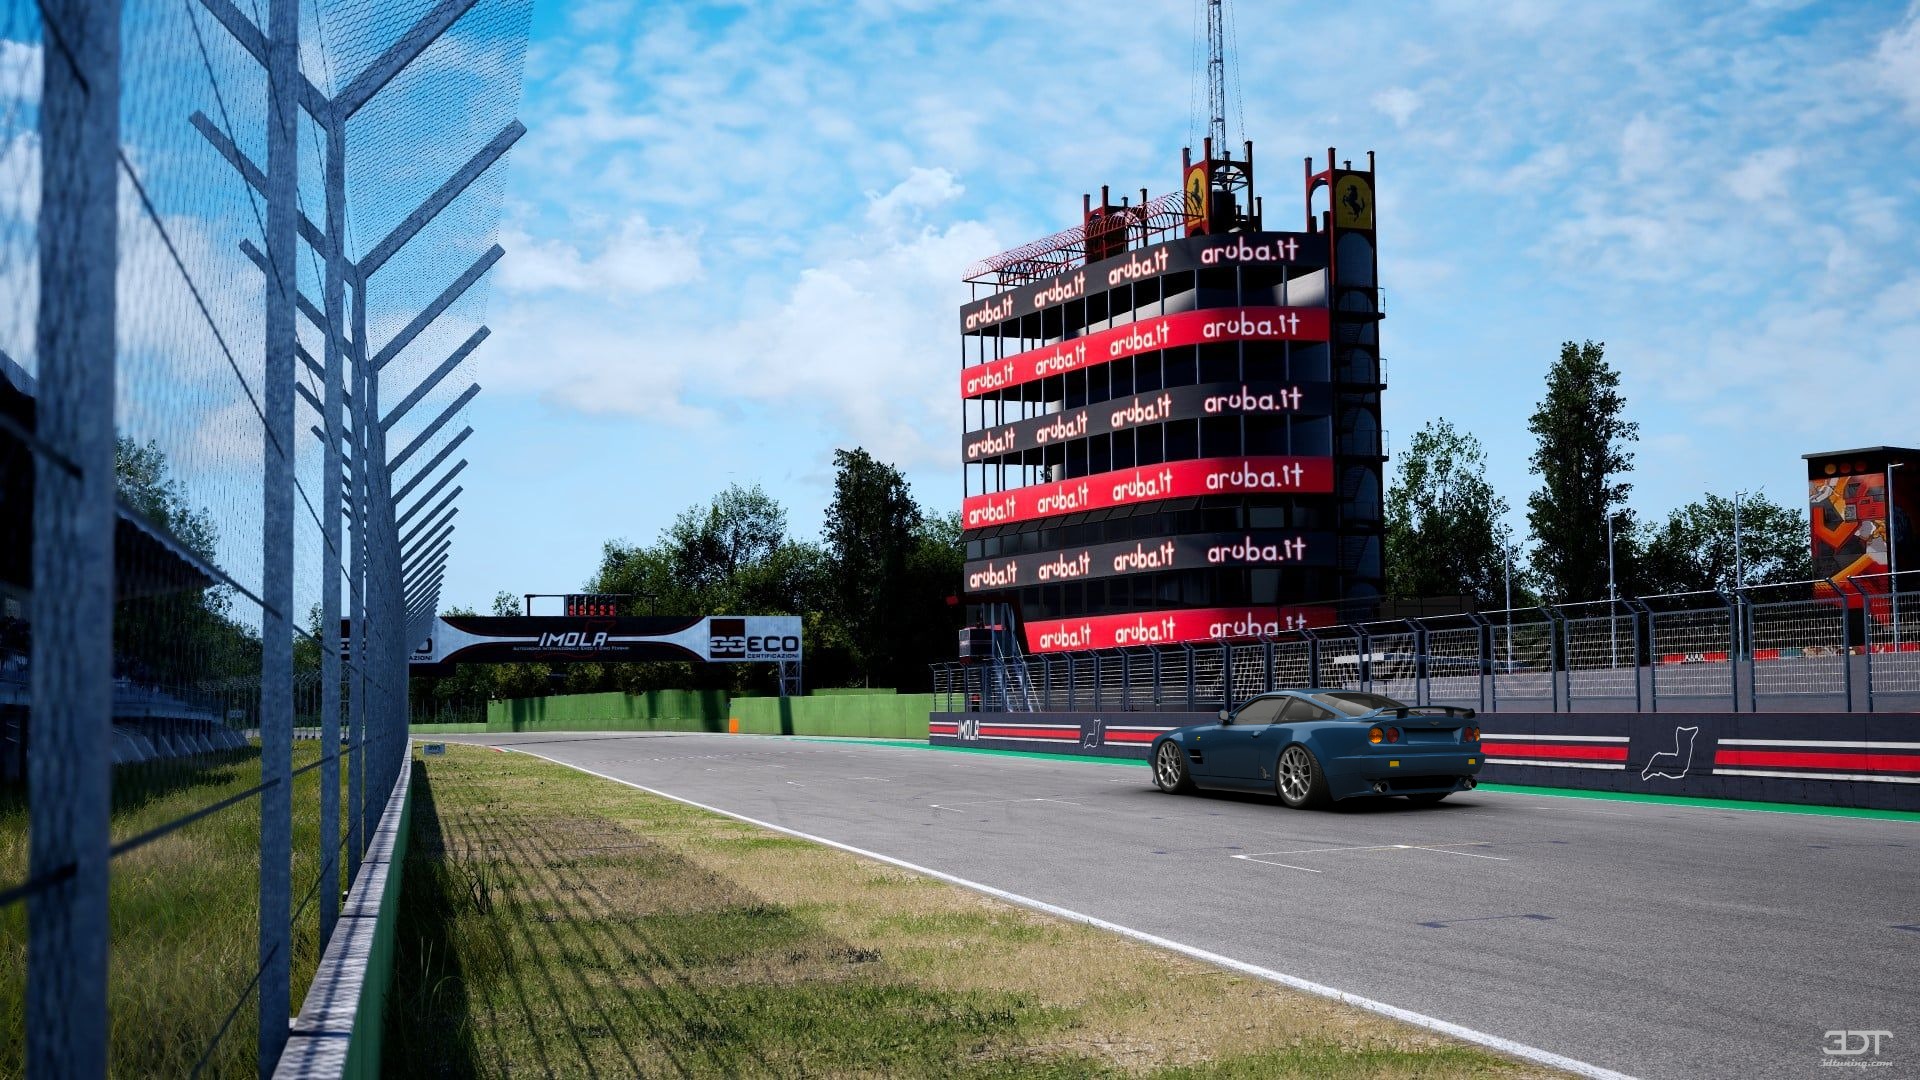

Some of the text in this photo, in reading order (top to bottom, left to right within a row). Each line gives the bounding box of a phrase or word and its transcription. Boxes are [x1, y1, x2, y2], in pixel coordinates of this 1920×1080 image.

[966, 237, 1299, 329] aruba.it aruba.it aruba.it aruba.it
[967, 312, 1300, 393] aruba.it aruba.it aruba.it aruba.it
[968, 386, 1302, 458] aruba.it aruba.it aruba.it aruba.it
[969, 462, 1303, 525] aruba.it aruba.it aruba.it aruba.it
[970, 536, 1306, 588] aruba.it aruba.it aruba.it aruba.it
[540, 632, 608, 647] IMOLA
[747, 636, 799, 652] ECO
[1040, 613, 1307, 649] aruba.it aruba.it arubait
[957, 720, 979, 741] IMOLA
